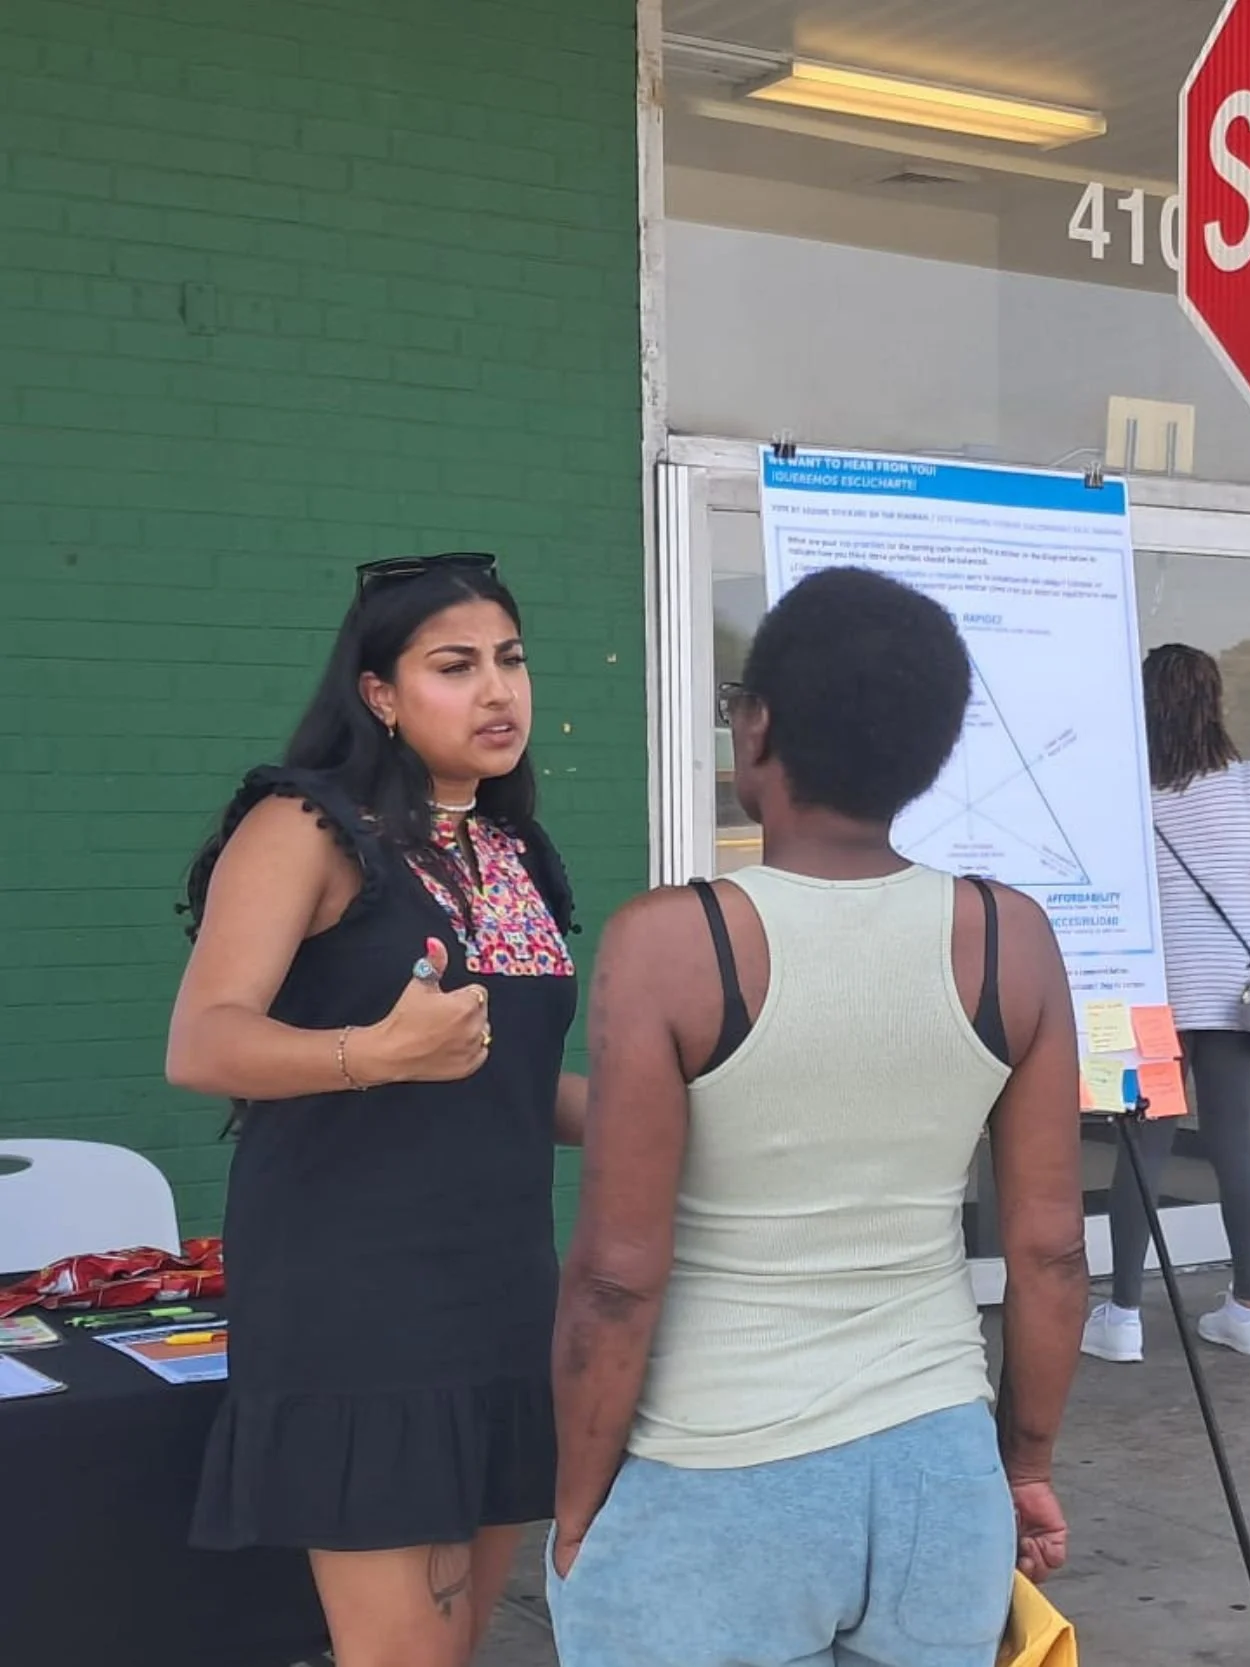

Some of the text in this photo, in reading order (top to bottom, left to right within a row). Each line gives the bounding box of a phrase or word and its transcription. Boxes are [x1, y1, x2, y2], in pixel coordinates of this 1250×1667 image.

[788, 457, 821, 468] WANT
[824, 458, 840, 470] TO
[844, 460, 873, 472] HEAR
[876, 462, 908, 474] FROM
[911, 464, 936, 477] YOU!
